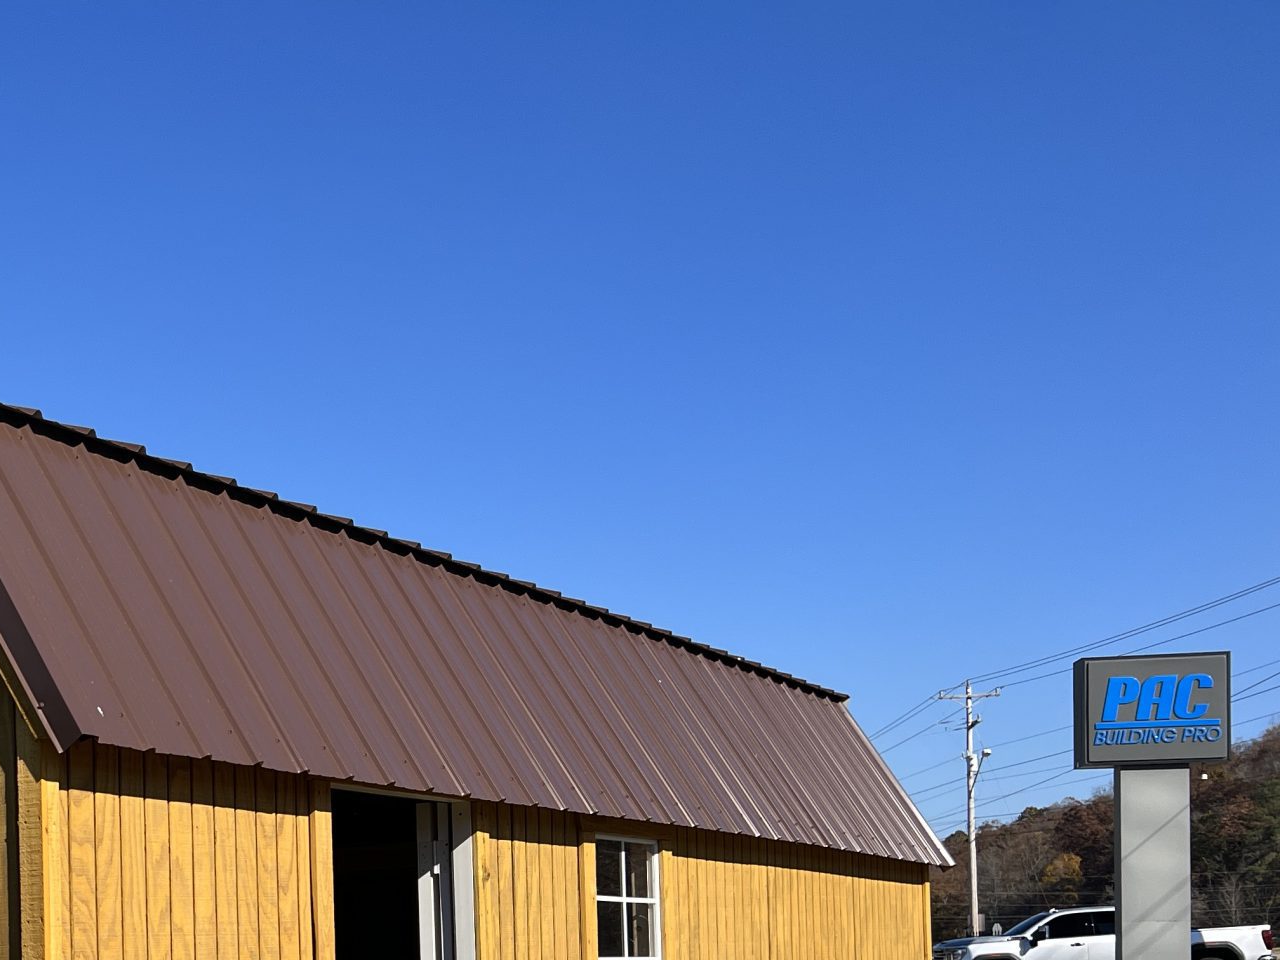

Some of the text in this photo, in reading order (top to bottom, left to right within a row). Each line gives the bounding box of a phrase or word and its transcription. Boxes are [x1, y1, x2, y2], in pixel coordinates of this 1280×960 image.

[1101, 673, 1214, 722] PAC
[1093, 726, 1223, 746] BUILDING PRO
